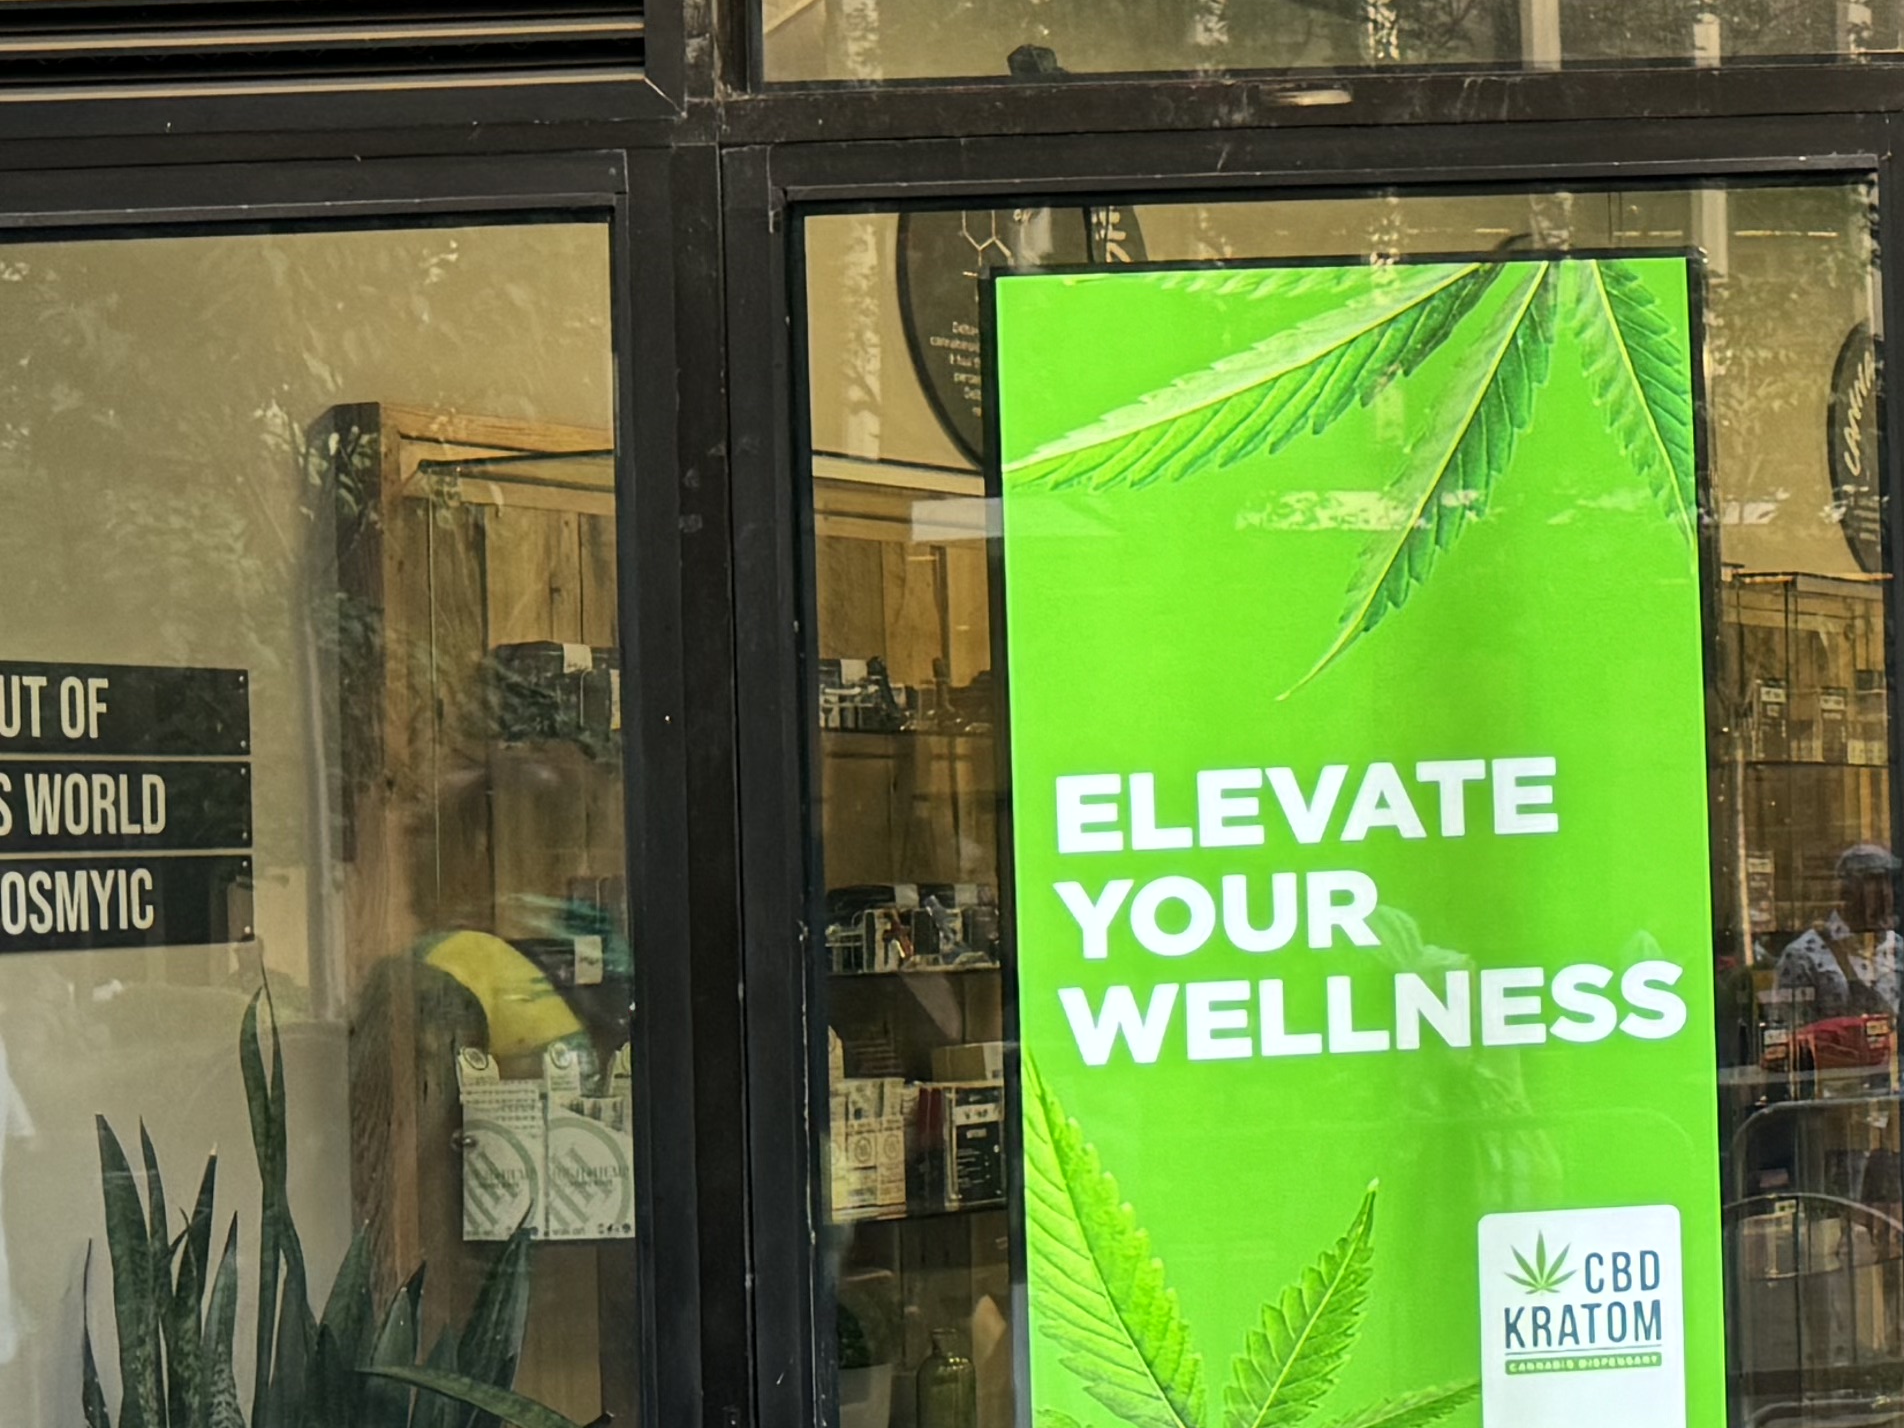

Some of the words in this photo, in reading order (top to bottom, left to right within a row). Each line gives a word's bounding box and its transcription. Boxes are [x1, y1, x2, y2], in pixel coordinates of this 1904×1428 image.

[60, 676, 109, 739] OF
[24, 773, 167, 835] WORLD
[1055, 756, 1559, 854] ELEVATE
[0, 868, 155, 935] OSMYIC
[1052, 870, 1381, 959] YOUR
[1057, 959, 1689, 1066] WELLNESS
[1584, 1250, 1660, 1294] CBD
[1504, 1299, 1662, 1349] KRATOM
